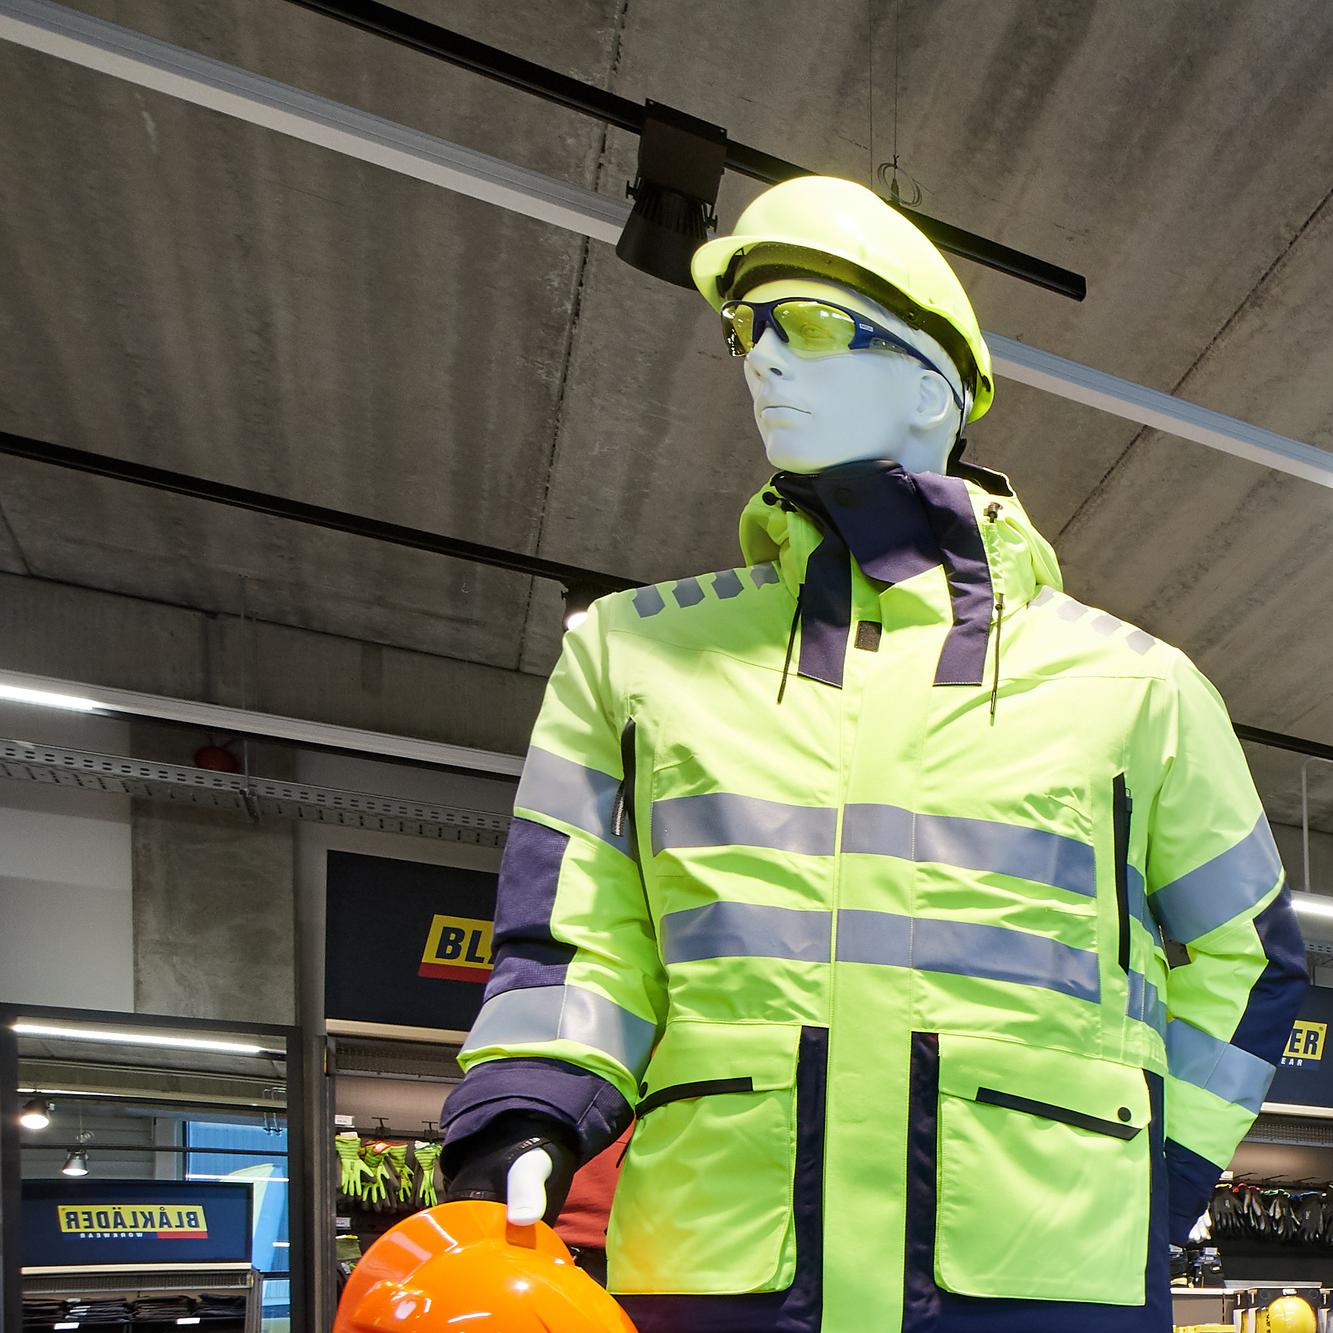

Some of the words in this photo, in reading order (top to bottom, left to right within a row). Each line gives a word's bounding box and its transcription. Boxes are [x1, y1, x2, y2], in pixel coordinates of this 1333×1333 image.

[435, 926, 495, 964] BL
[1289, 1028, 1320, 1055] ER
[1280, 1057, 1303, 1067] EAR
